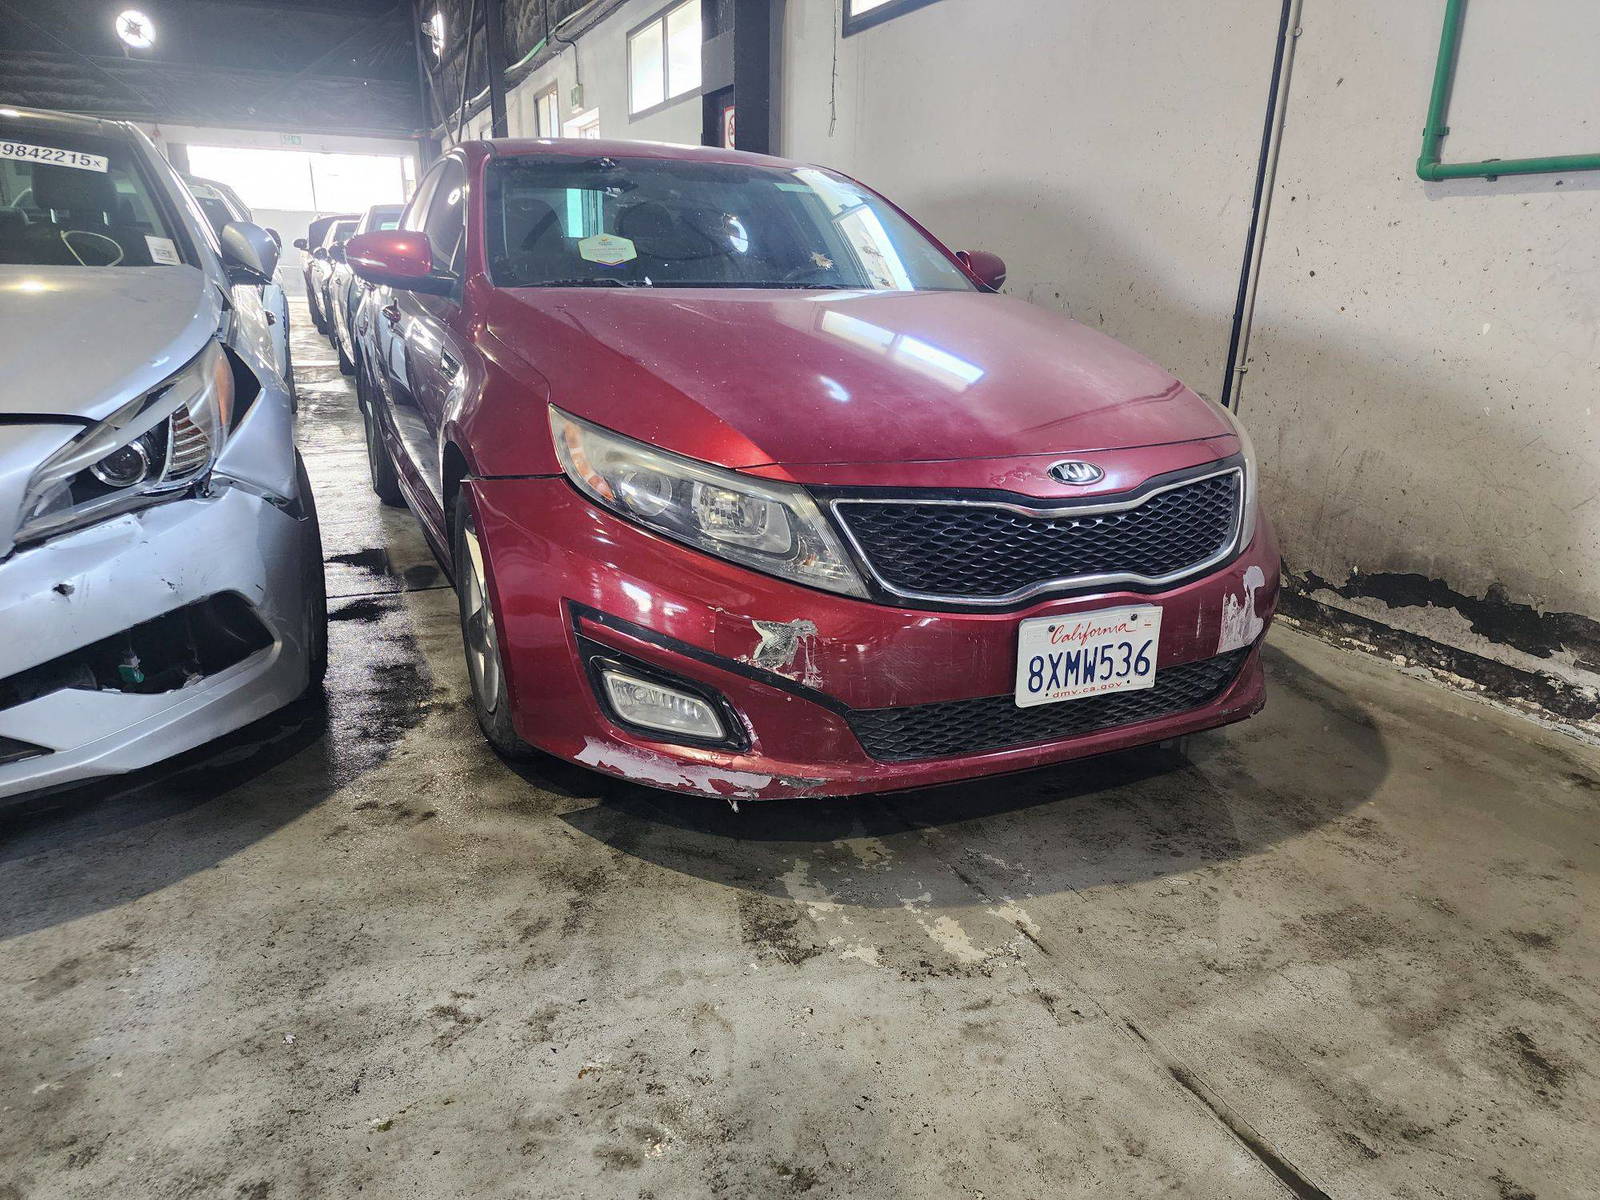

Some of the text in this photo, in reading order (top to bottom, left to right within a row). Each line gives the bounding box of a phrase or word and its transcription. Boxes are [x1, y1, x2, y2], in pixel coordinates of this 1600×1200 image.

[0, 143, 102, 168] 9842215x
[1056, 463, 1099, 480] KIA
[1051, 621, 1136, 646] California
[1028, 640, 1153, 693] 8XMW536
[1052, 681, 1122, 699] dmv.ca.gov
